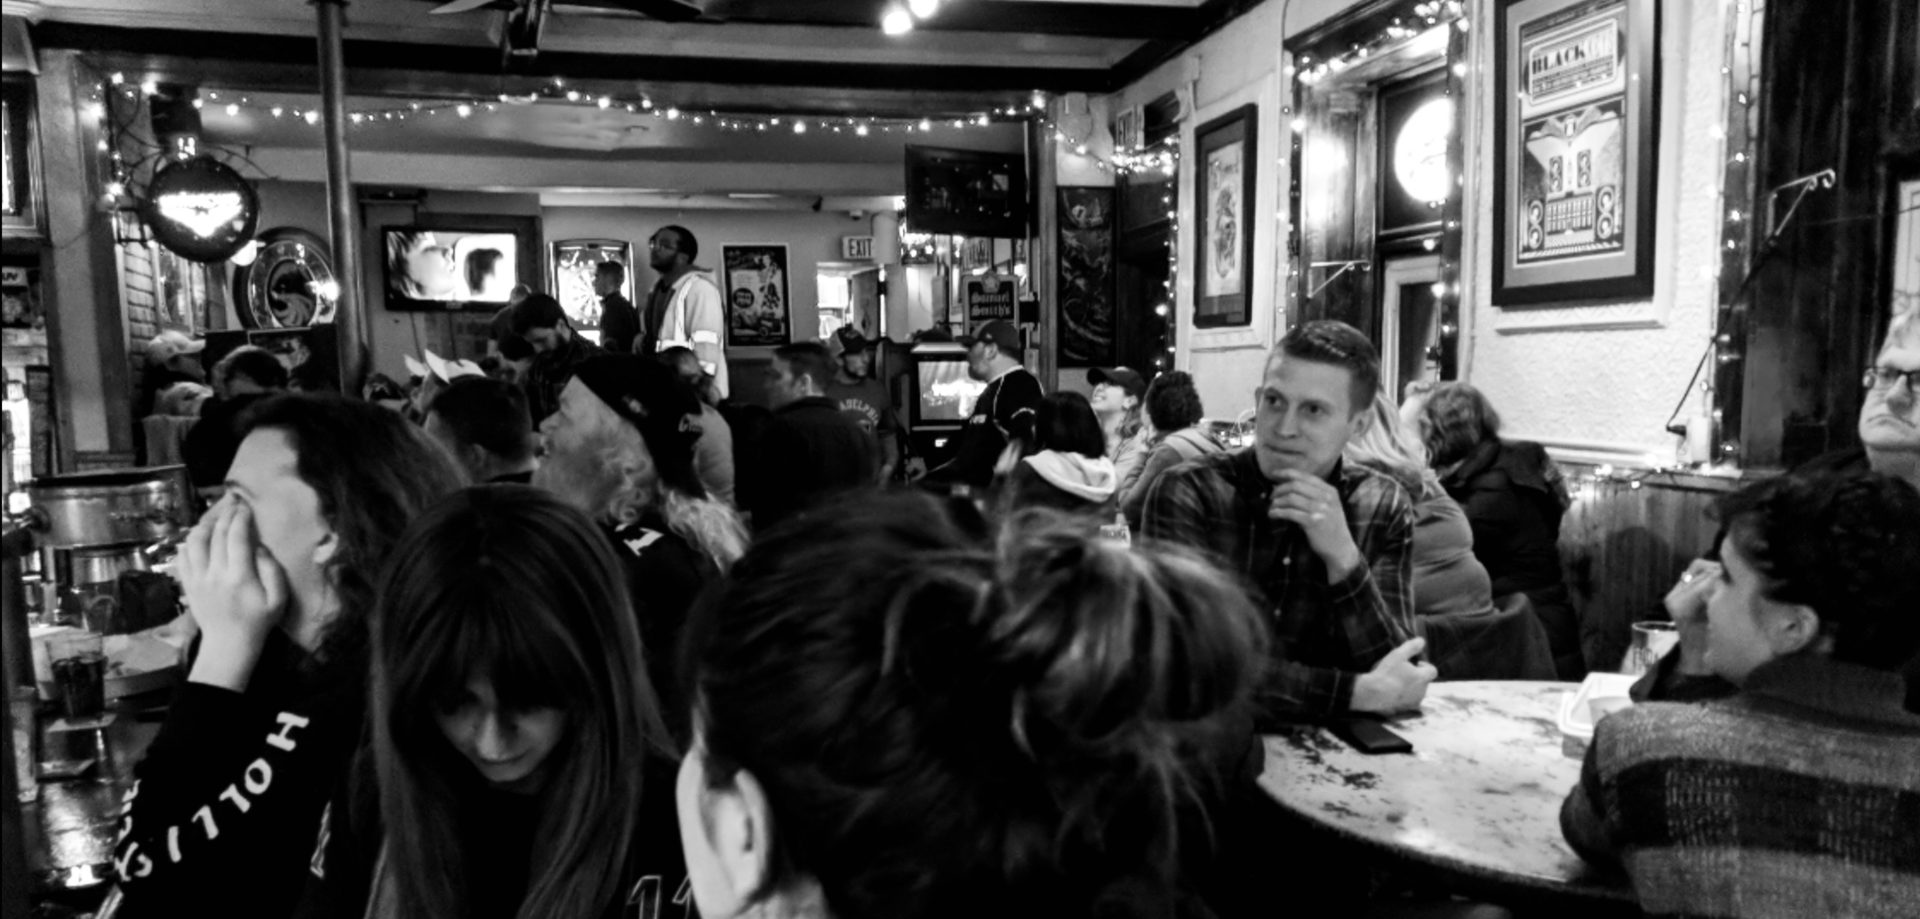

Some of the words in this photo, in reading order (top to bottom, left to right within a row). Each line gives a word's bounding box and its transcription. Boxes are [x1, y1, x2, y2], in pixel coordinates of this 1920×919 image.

[848, 238, 873, 257] EXIT
[971, 291, 1010, 304] Samuel
[971, 304, 1011, 318] Smith's
